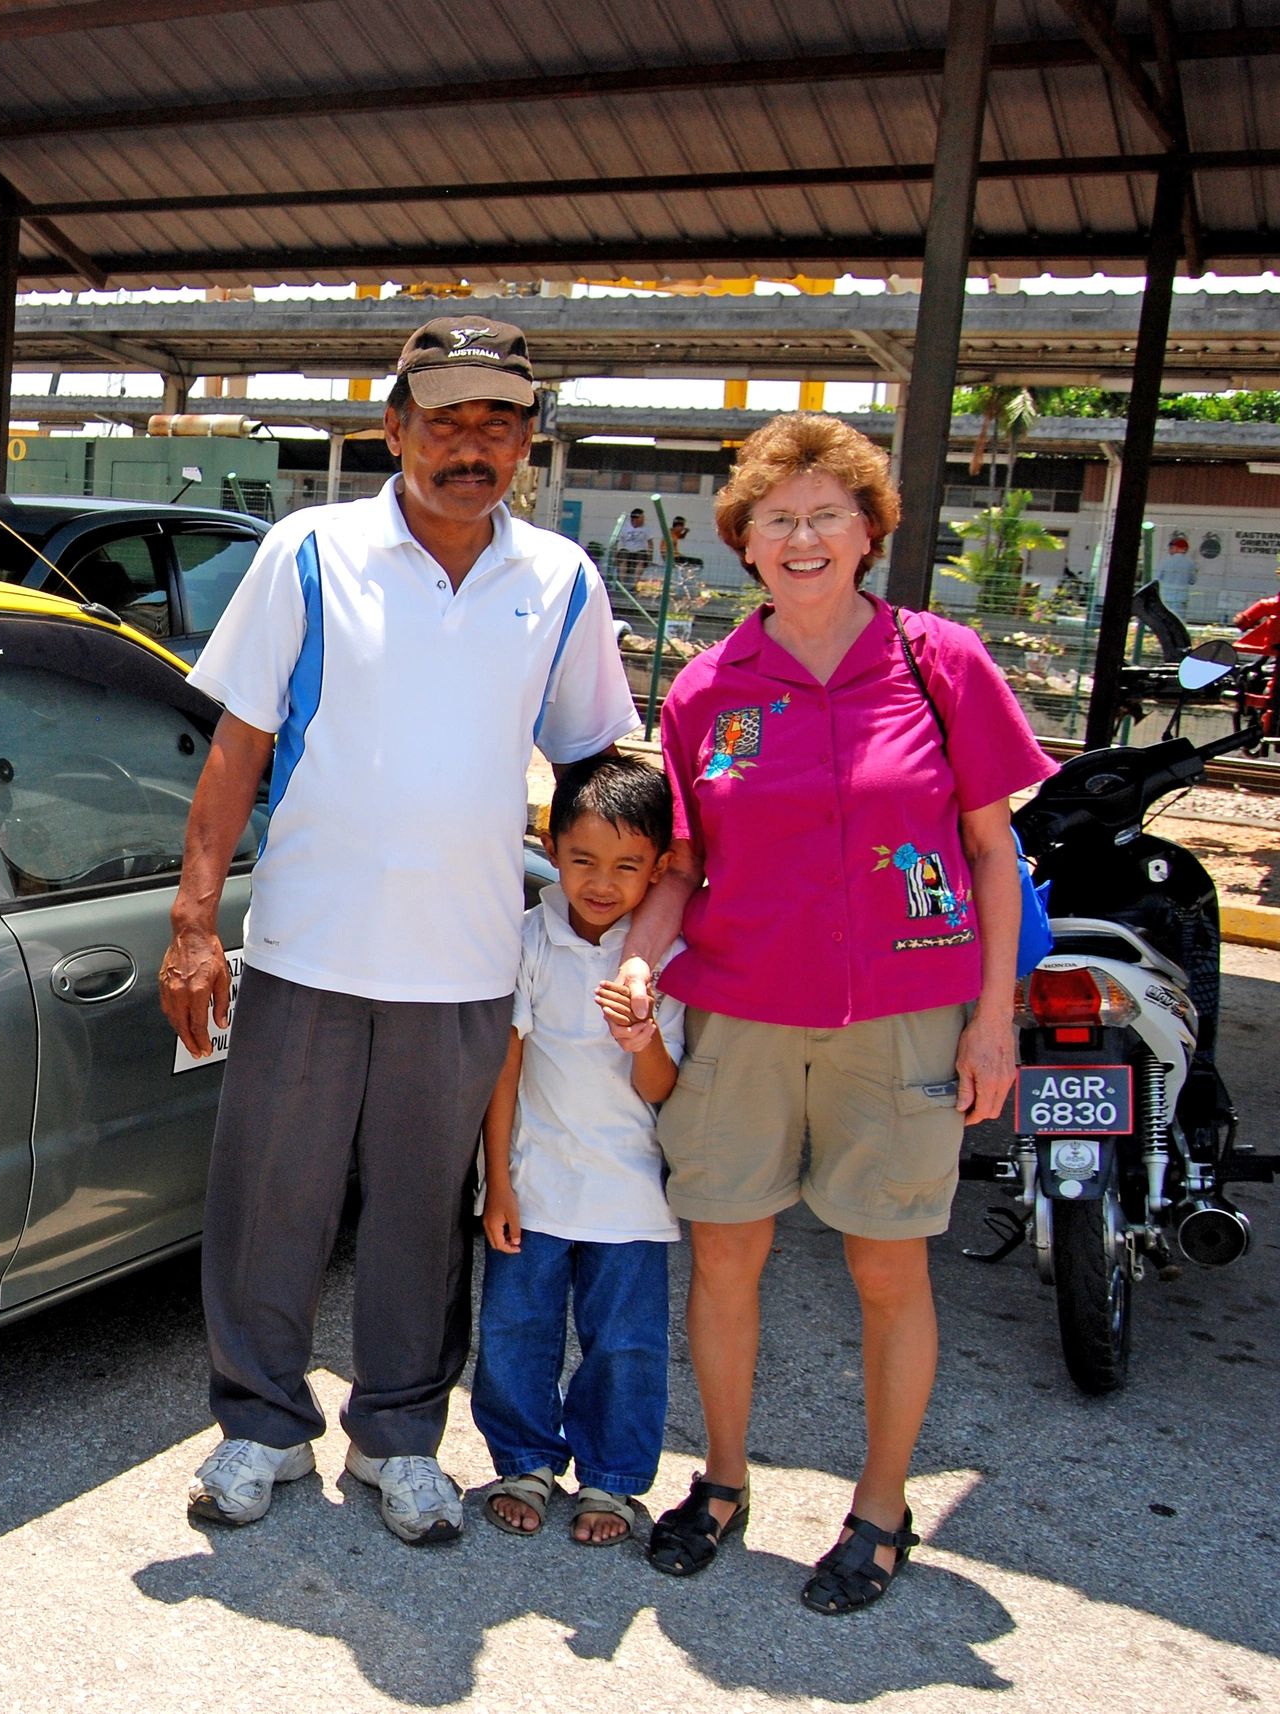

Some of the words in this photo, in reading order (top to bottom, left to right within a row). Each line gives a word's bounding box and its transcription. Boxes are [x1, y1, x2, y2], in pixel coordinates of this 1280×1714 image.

[448, 348, 500, 360] AUSTRALIA
[1039, 1076, 1106, 1099] AGR
[1030, 1102, 1117, 1125] 6830
